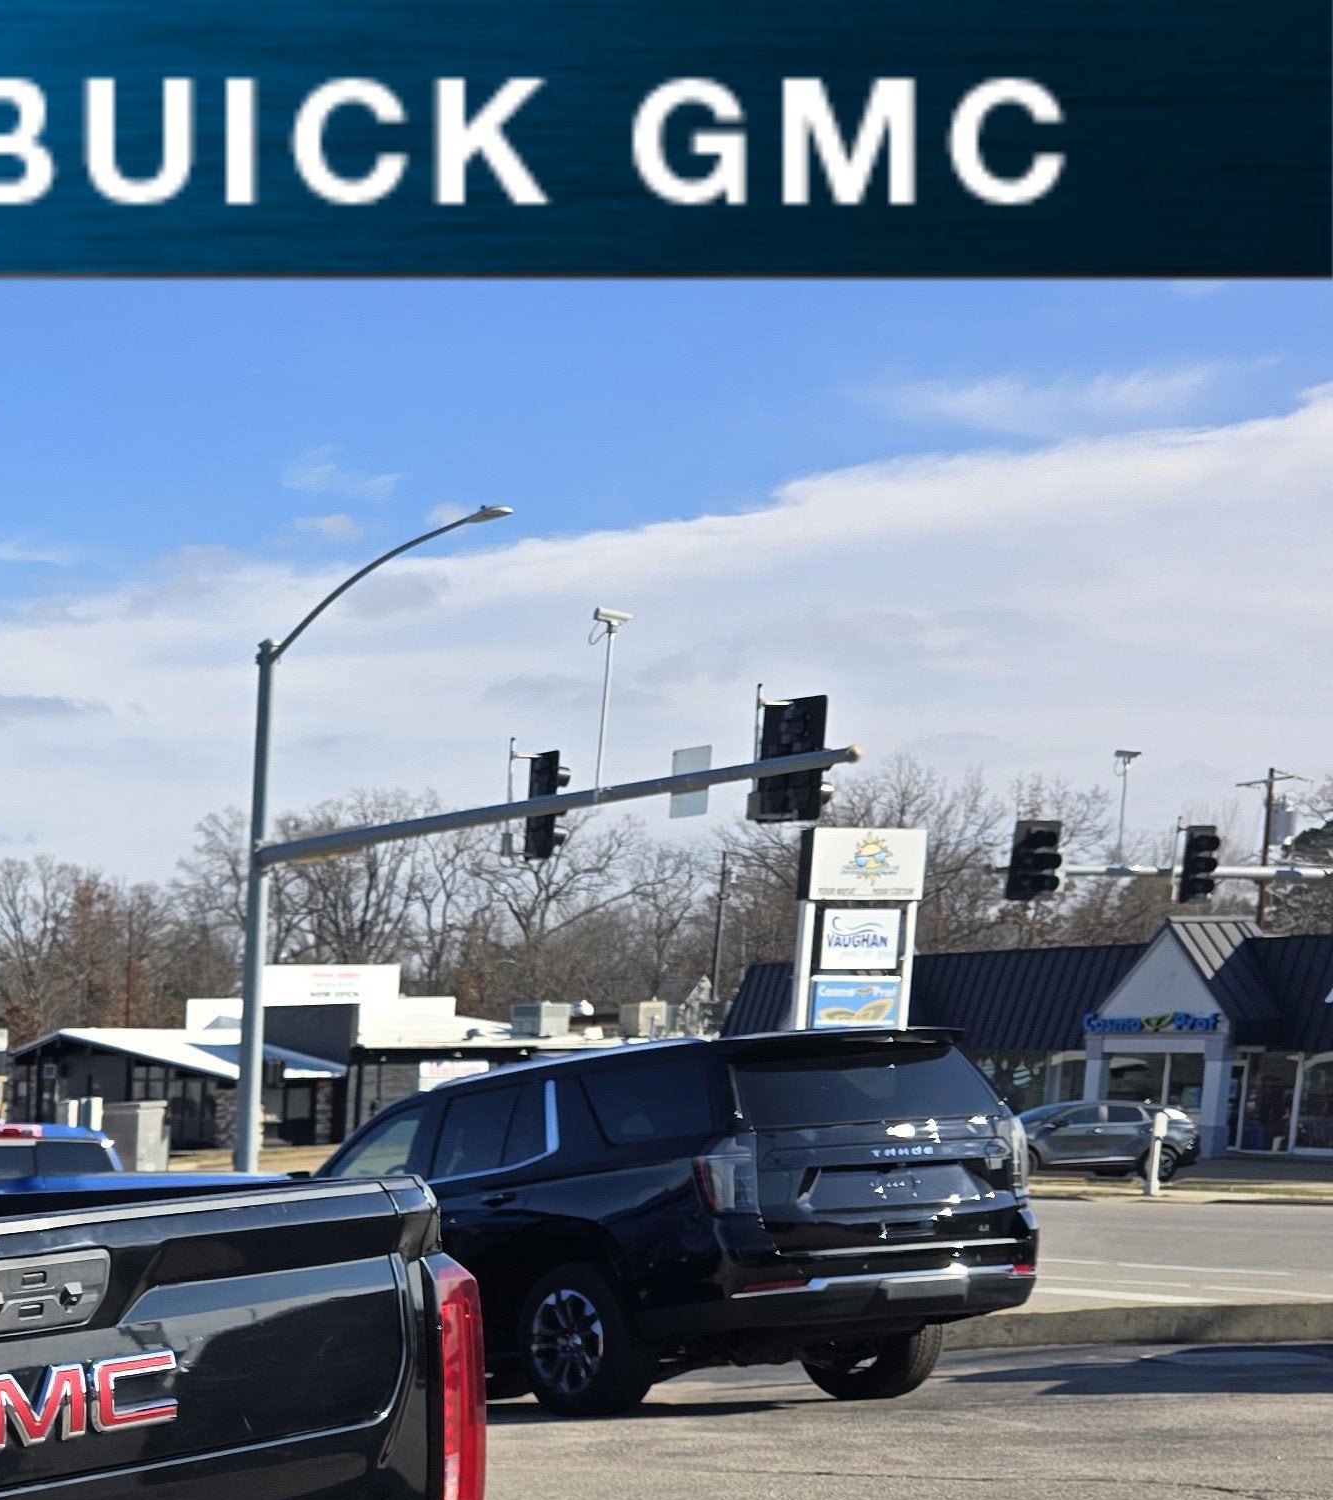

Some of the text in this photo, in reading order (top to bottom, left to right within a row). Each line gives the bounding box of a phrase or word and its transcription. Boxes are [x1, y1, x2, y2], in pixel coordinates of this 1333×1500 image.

[826, 934, 888, 948] VAUGHAN
[1083, 1011, 1221, 1033] Cosmo Prof
